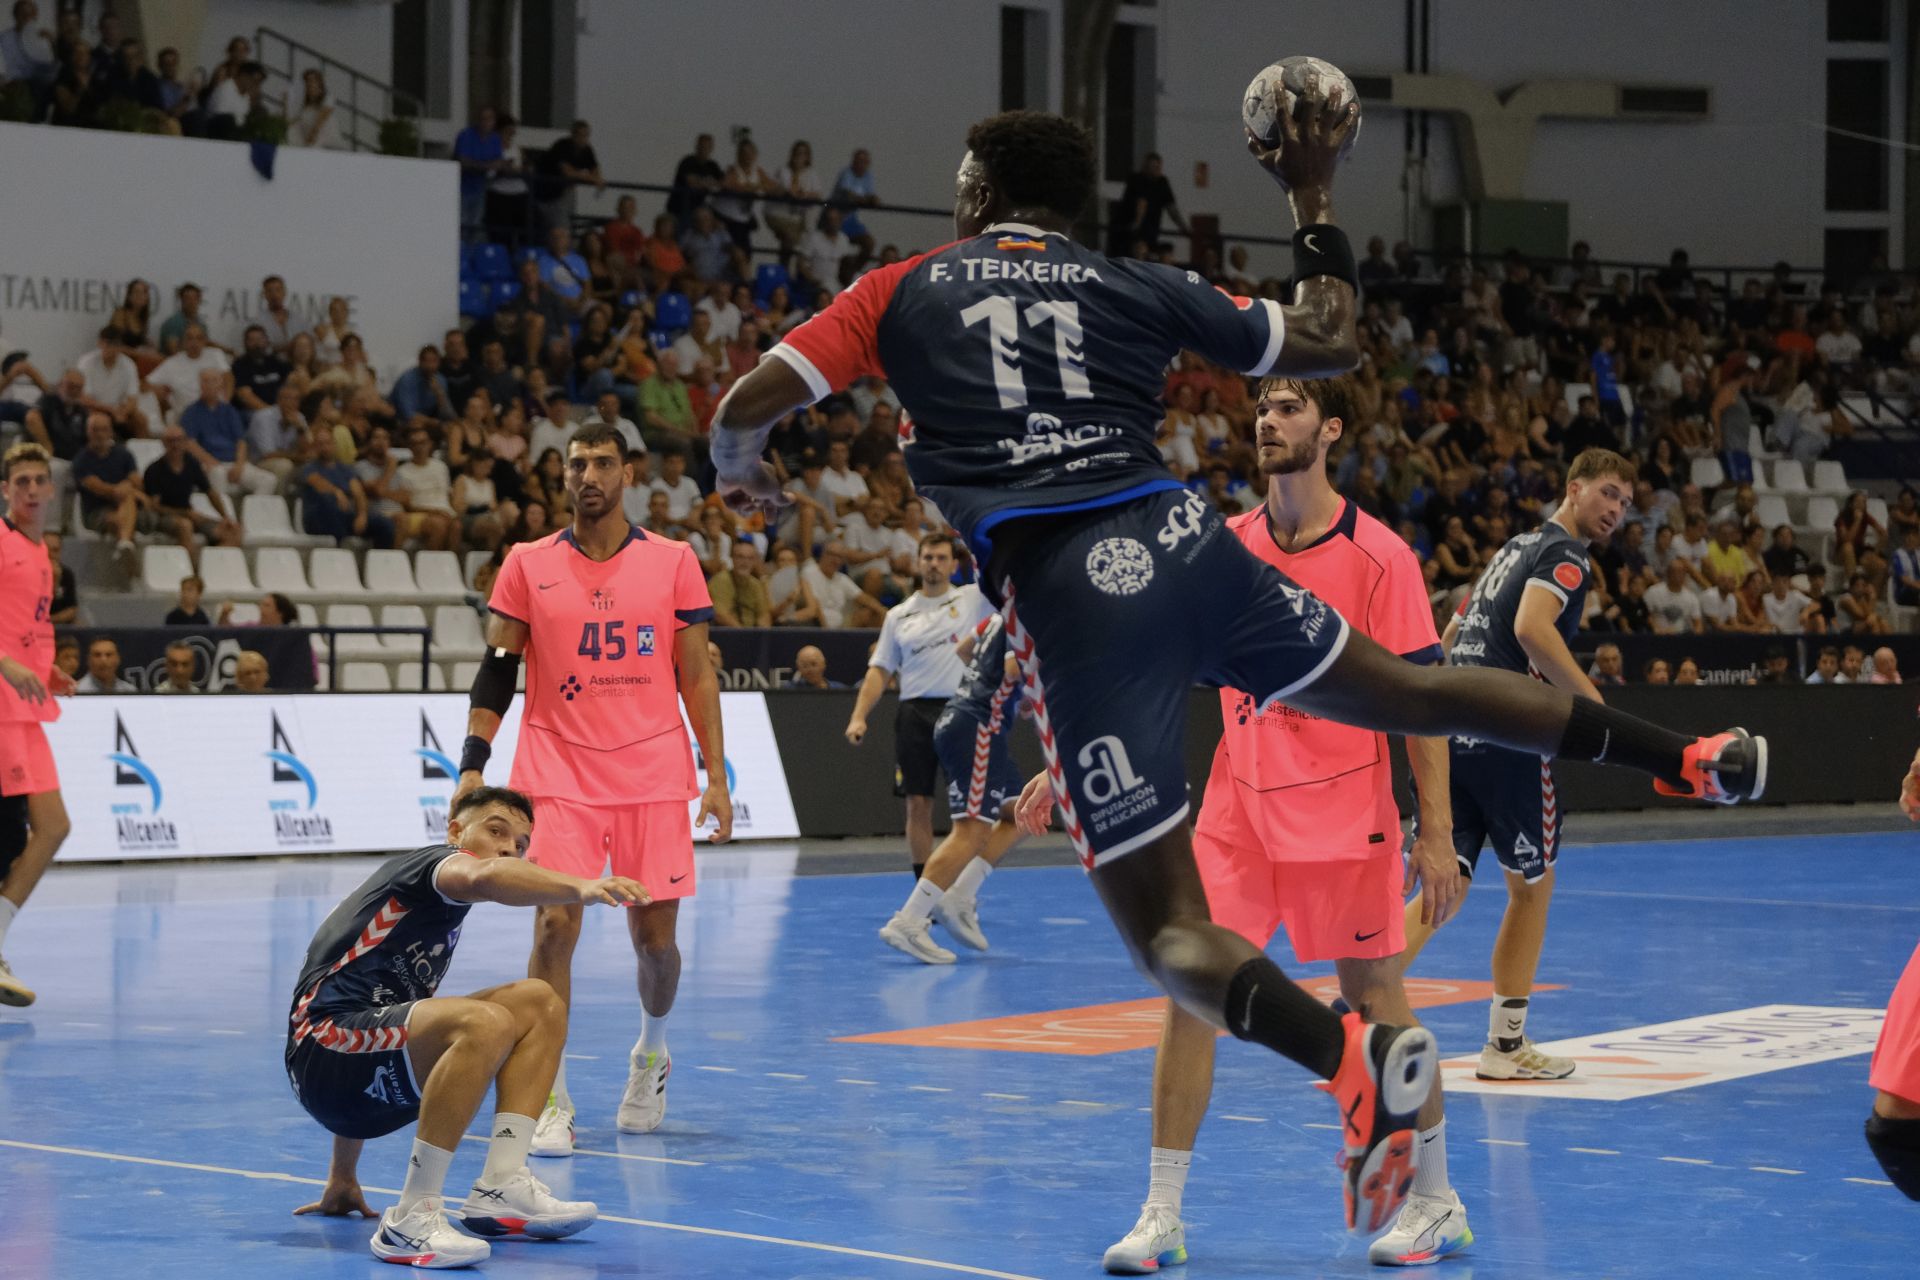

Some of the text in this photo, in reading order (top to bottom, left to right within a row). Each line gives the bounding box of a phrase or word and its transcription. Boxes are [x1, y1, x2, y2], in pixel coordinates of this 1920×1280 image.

[929, 257, 1103, 283] F. TEIXEIRA
[960, 294, 1094, 409] 11
[578, 620, 626, 661] 45
[117, 816, 177, 842] Alicante
[276, 812, 333, 837] Alicante
[1094, 795, 1159, 833] DE ALICANTE
